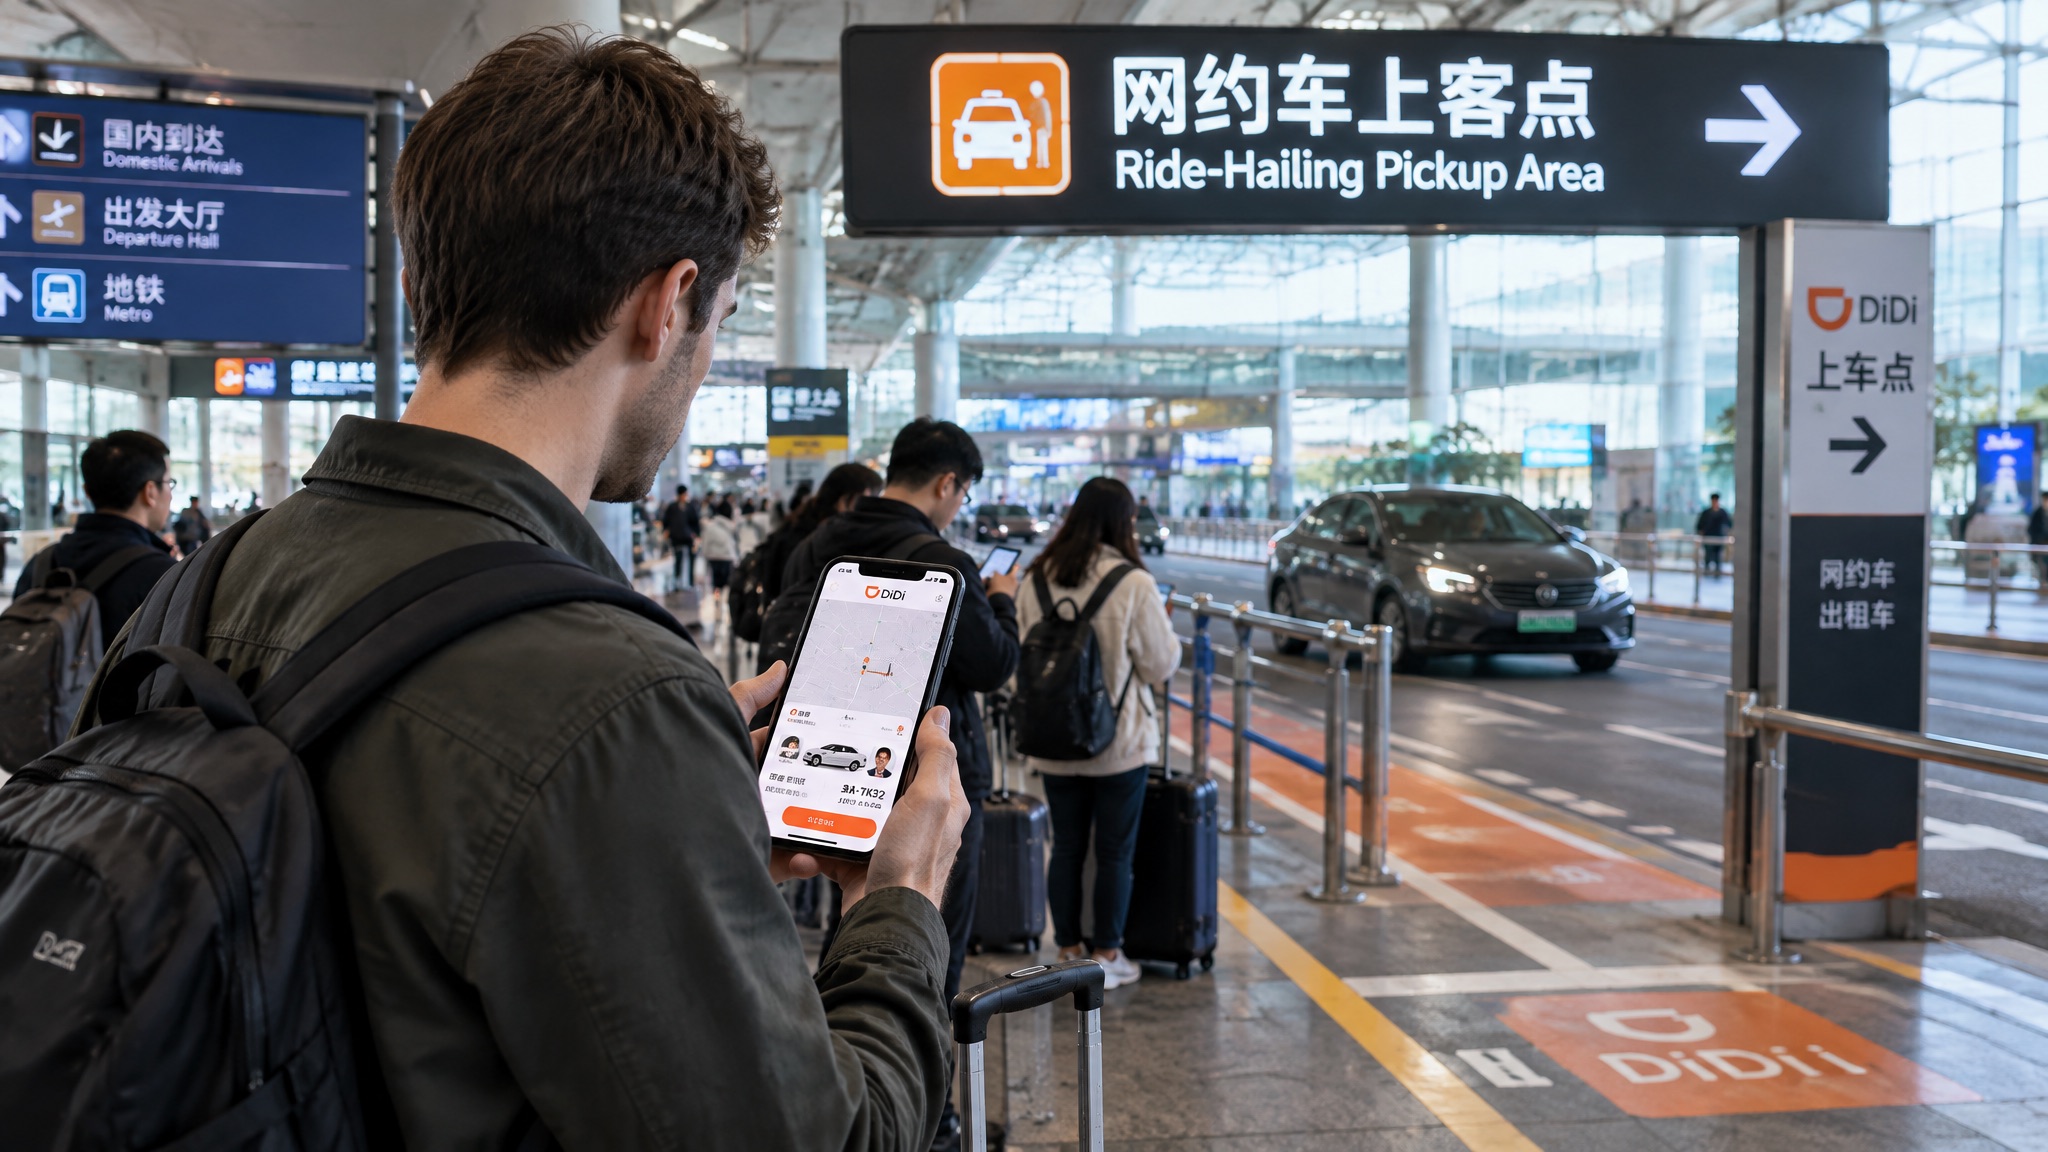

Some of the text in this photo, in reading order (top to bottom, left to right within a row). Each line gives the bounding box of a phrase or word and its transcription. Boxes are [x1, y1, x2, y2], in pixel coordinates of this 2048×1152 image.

[1113, 53, 1595, 139] 网约车上客点
[103, 119, 224, 155] 国内到达
[103, 150, 243, 175] Domestic Arrivals
[1115, 149, 1604, 199] Ride-Hailing Pickup Area
[104, 196, 224, 231] 出发大厅
[104, 228, 219, 249] Departure Hall
[104, 274, 165, 305] 地铁
[105, 306, 153, 322] Metro
[1859, 296, 1917, 324] DiDi
[1807, 351, 1914, 393] 上车点
[1819, 558, 1895, 590] 网约车
[881, 589, 907, 601] DiDi
[1819, 599, 1895, 630] 出租车
